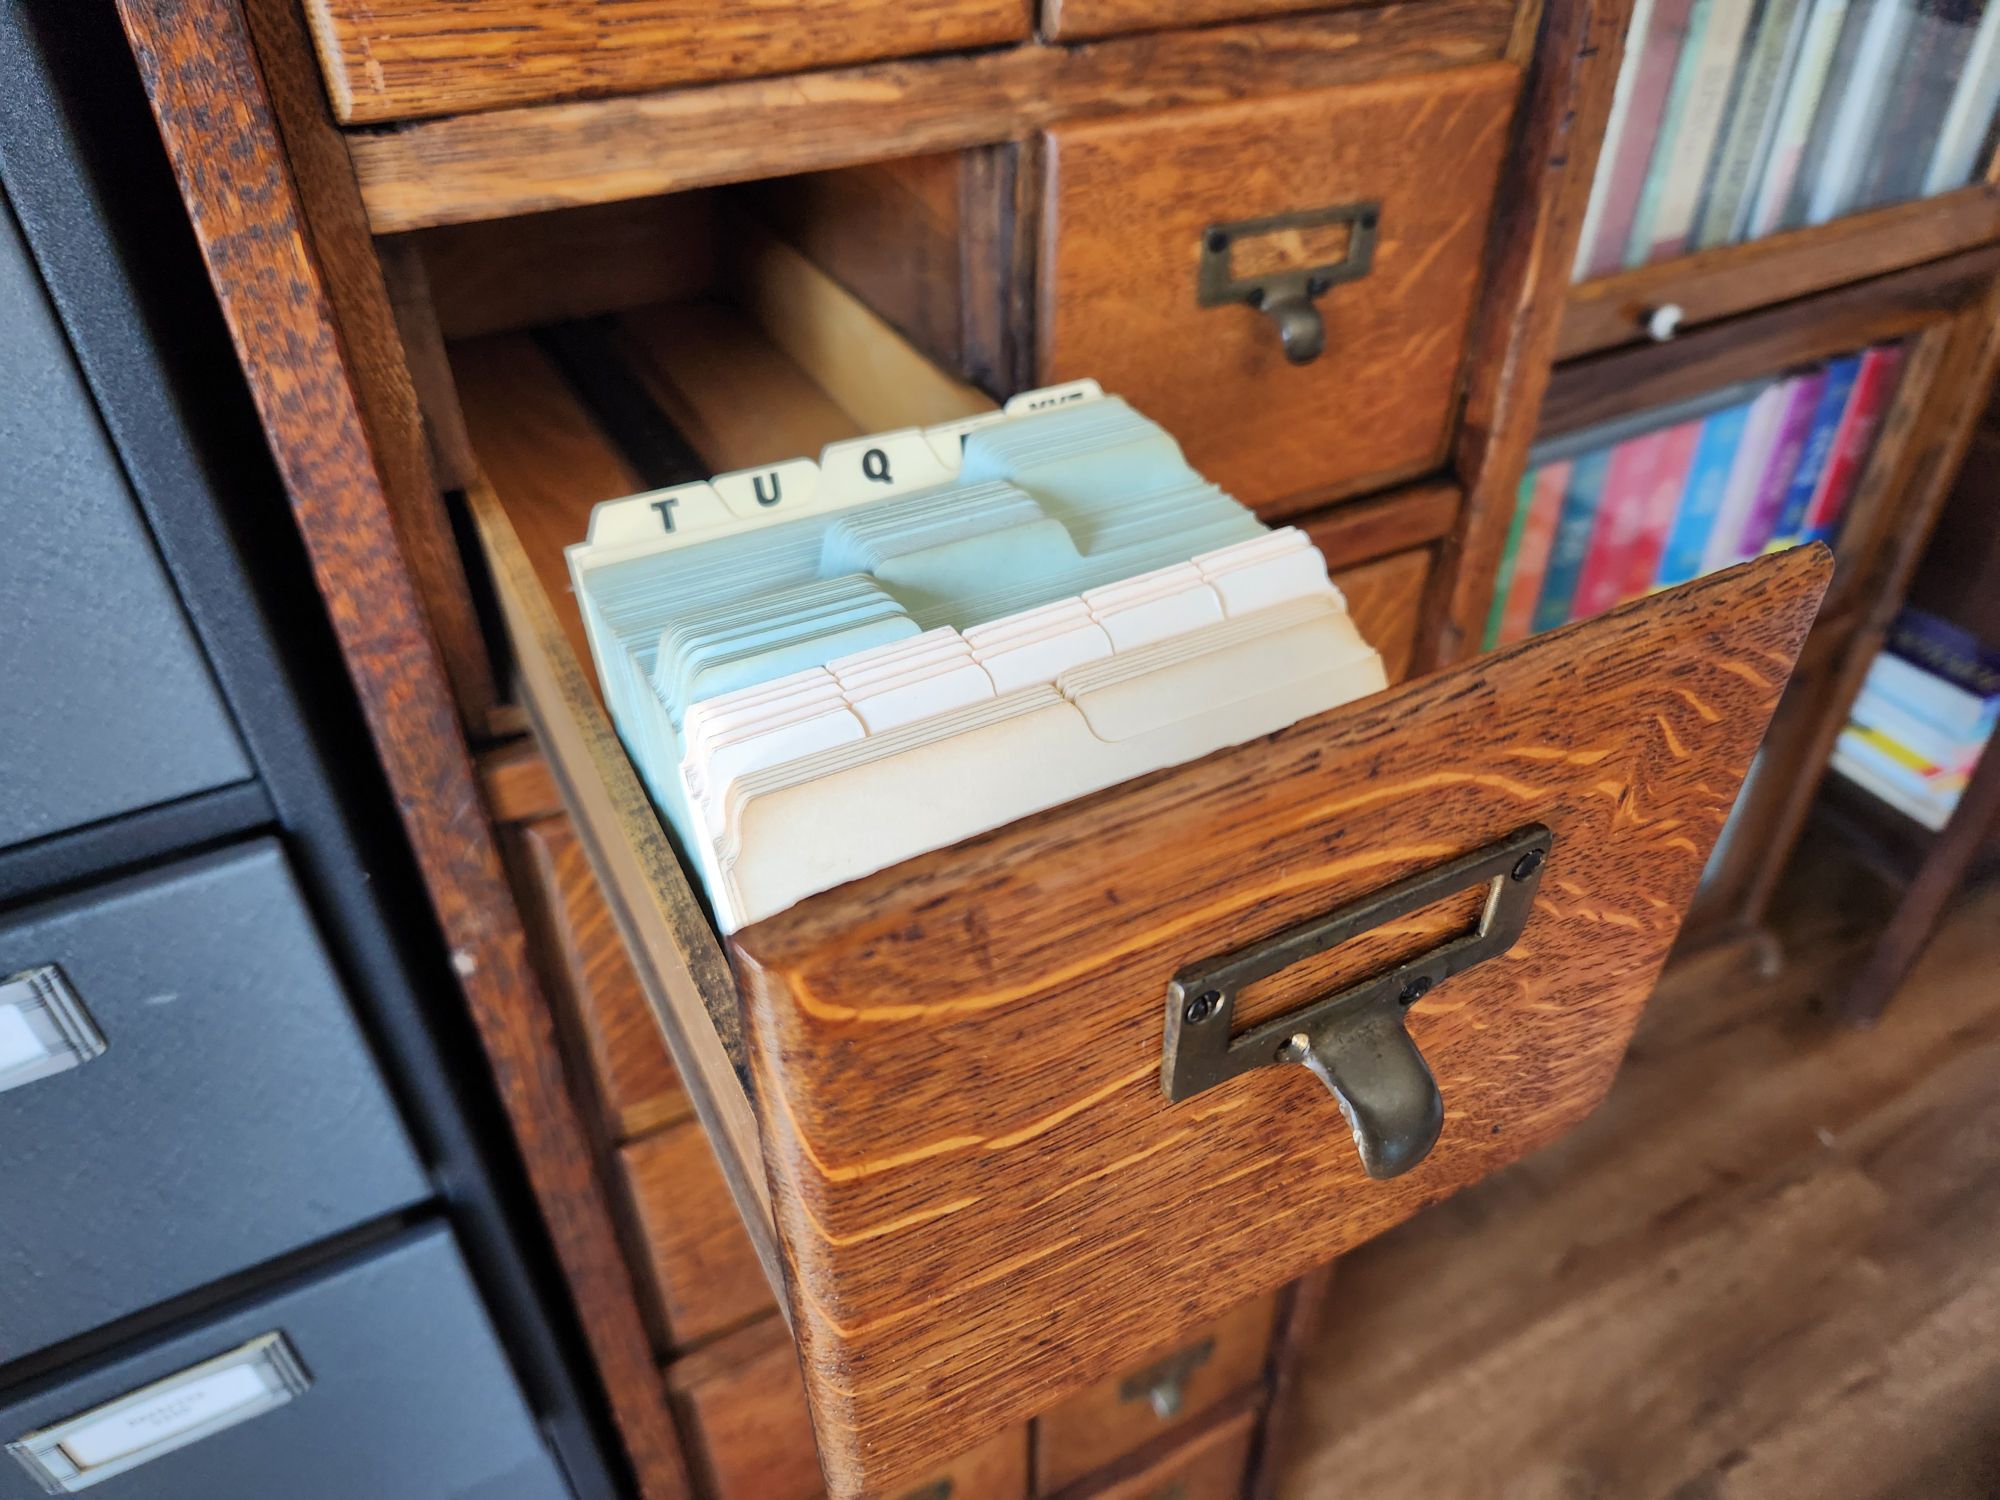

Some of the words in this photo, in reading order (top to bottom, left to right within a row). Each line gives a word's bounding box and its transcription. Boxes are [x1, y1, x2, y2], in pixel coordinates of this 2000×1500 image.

[862, 448, 893, 484] Q
[752, 472, 782, 507] U
[651, 498, 679, 533] T
